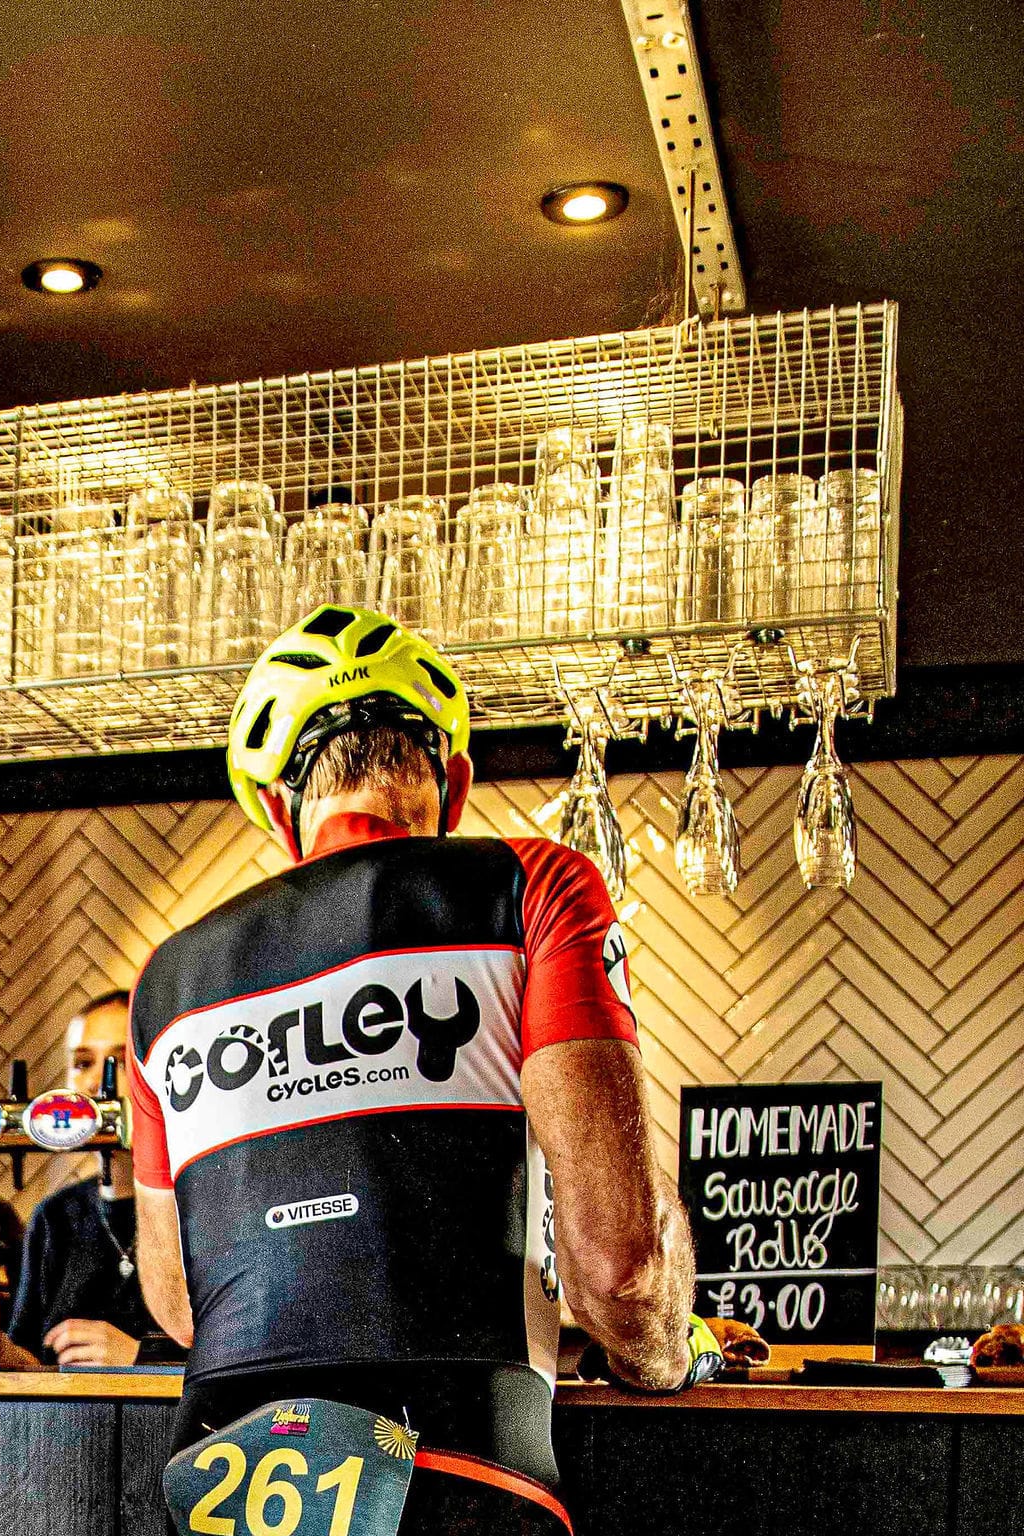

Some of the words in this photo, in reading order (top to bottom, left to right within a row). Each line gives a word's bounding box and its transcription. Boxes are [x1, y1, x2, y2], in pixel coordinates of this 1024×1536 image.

[329, 666, 370, 687] KASK
[690, 1101, 876, 1161] HOMEMADE
[286, 1198, 353, 1221] VITESSE
[702, 1167, 860, 1243] Sausage
[725, 1219, 829, 1272] Rolls
